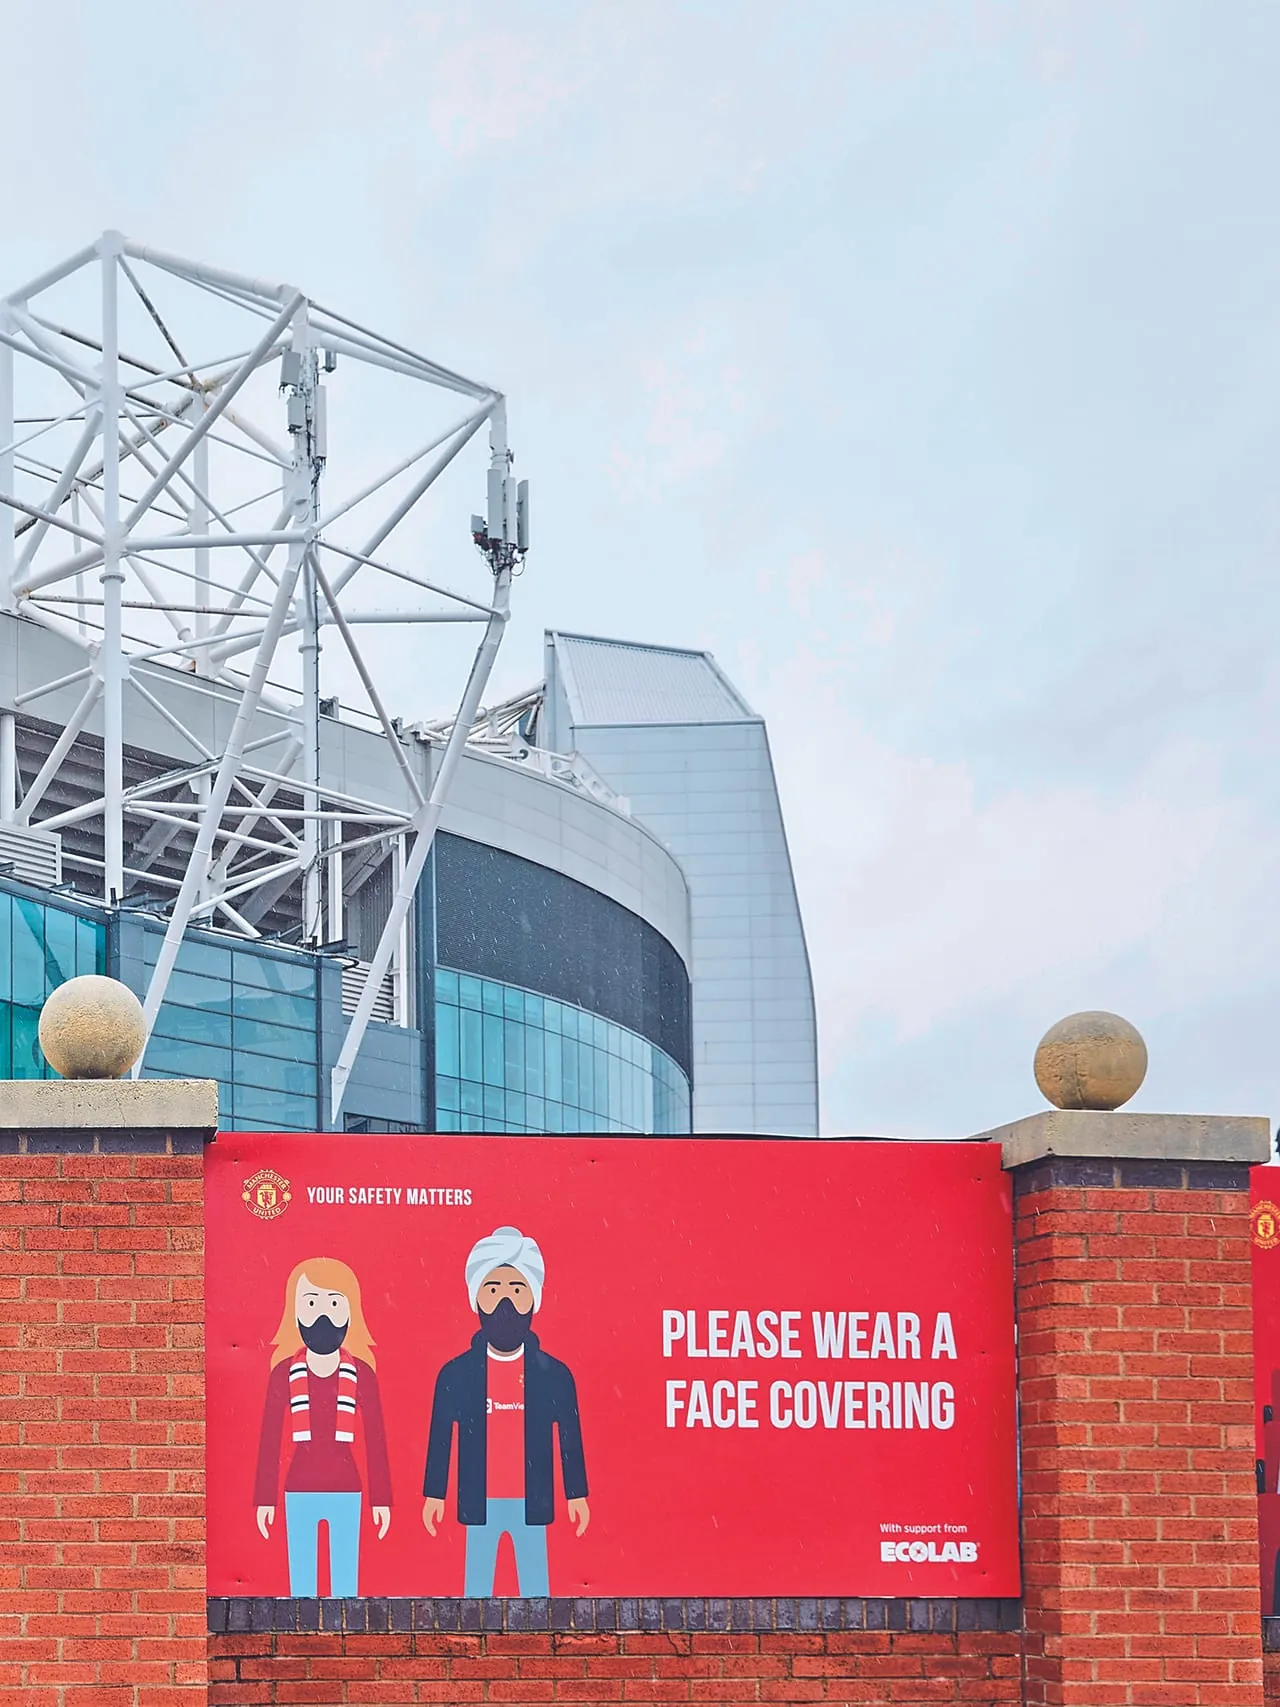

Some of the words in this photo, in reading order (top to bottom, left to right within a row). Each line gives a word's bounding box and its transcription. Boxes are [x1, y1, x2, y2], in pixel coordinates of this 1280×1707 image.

[246, 1173, 288, 1190] MANCHESTER
[306, 1187, 345, 1204] YOUR
[348, 1187, 402, 1205] SAFETY
[406, 1188, 473, 1206] MATTERS
[253, 1206, 281, 1217] UNITED
[662, 1310, 803, 1359] PLEASE
[811, 1311, 922, 1360] WEAR
[930, 1312, 958, 1360] A
[665, 1380, 760, 1429] FACE
[769, 1380, 955, 1430] COVERING
[879, 1523, 902, 1533] With
[903, 1523, 942, 1535] support
[943, 1523, 968, 1533] from
[880, 1541, 978, 1563] ECOLAB
